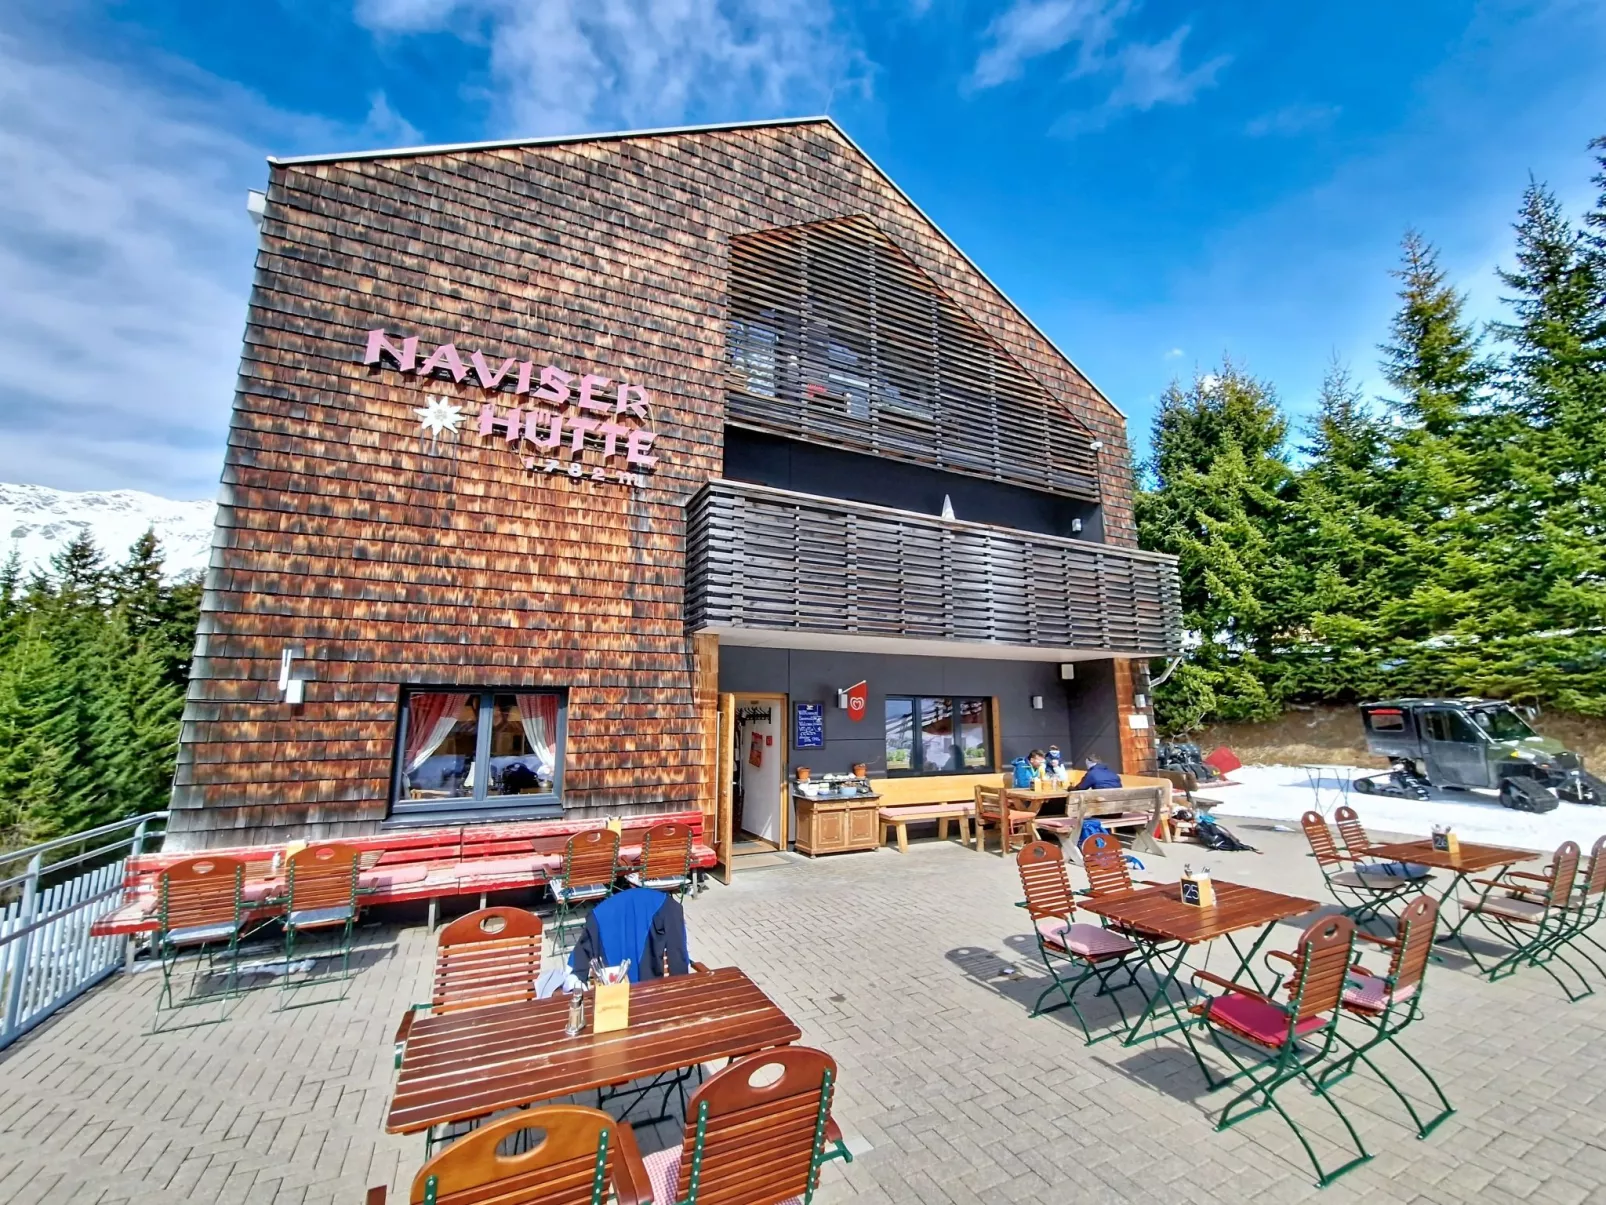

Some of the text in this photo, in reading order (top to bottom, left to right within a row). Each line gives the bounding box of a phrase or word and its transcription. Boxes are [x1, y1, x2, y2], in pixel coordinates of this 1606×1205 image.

[364, 328, 650, 419] NAVISER
[478, 403, 660, 466] HÜTTE
[1435, 835, 1447, 848] 26
[1183, 883, 1199, 900] 25
